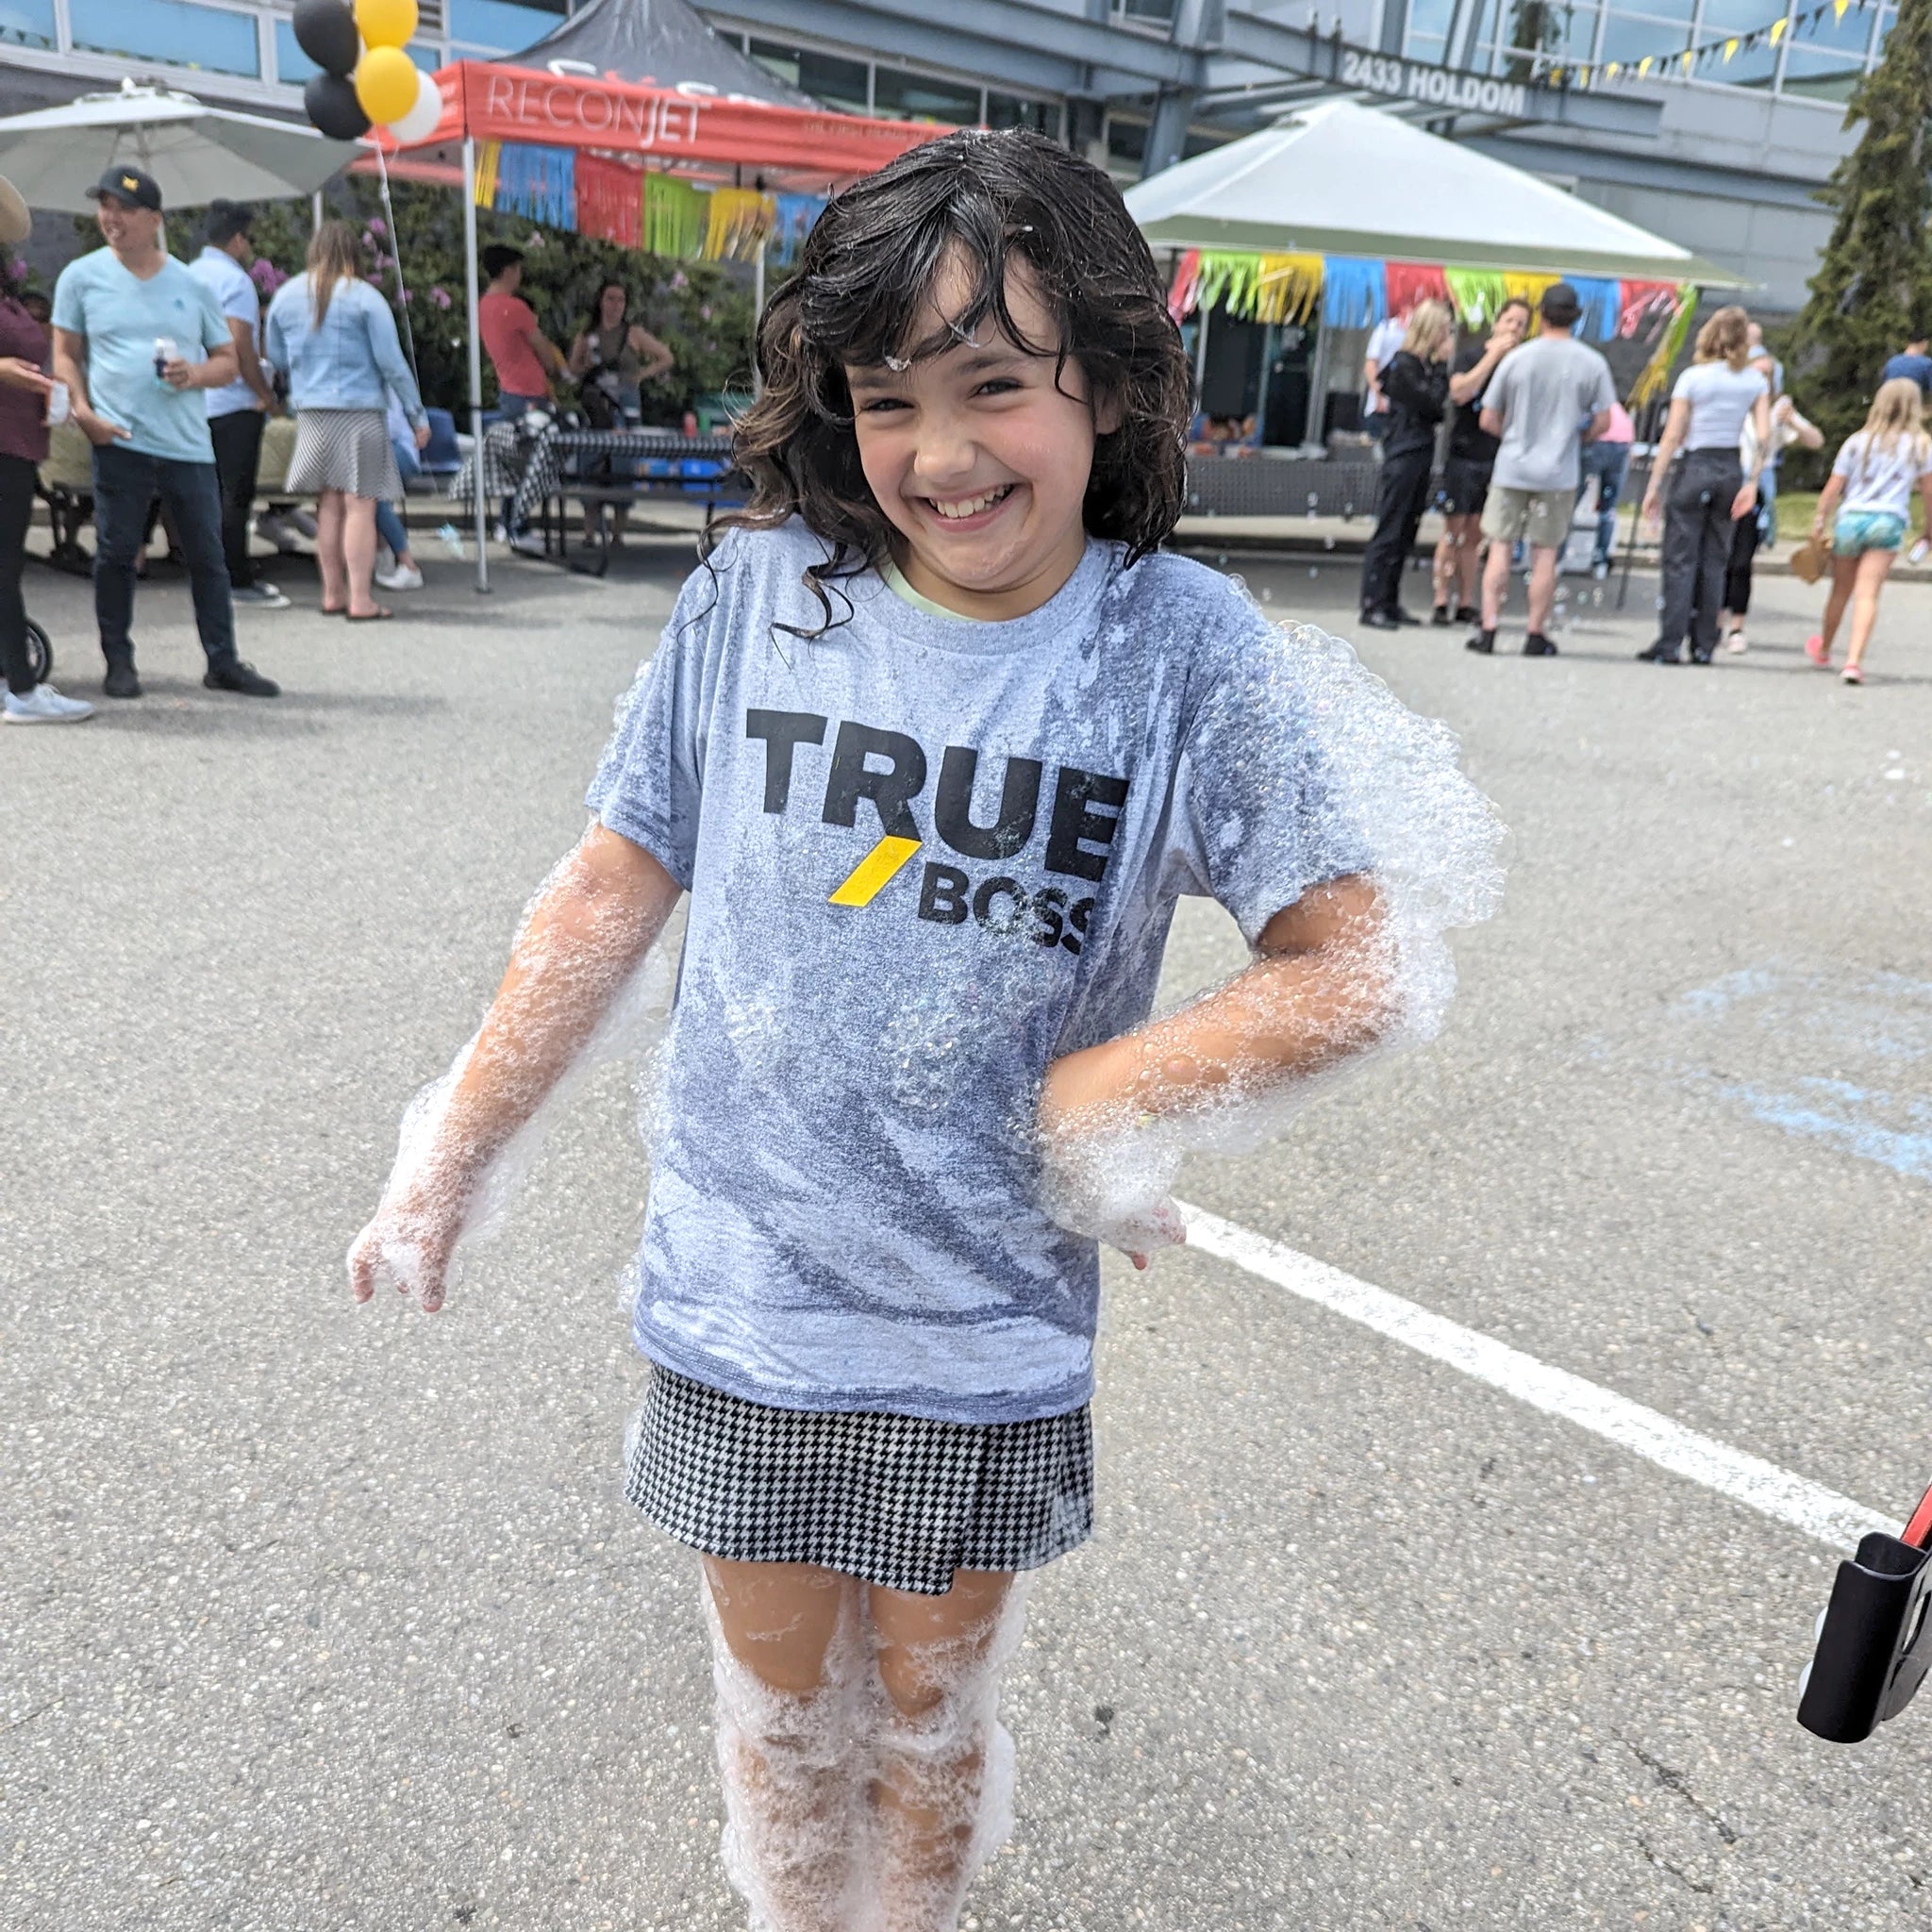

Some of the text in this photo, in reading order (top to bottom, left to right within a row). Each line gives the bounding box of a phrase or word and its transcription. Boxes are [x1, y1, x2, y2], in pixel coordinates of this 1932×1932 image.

[487, 75, 711, 148] RECONJET
[1343, 51, 1525, 116] 2433 HOLDOM
[746, 708, 1130, 882] TRUE
[918, 861, 1094, 956] BOSS
